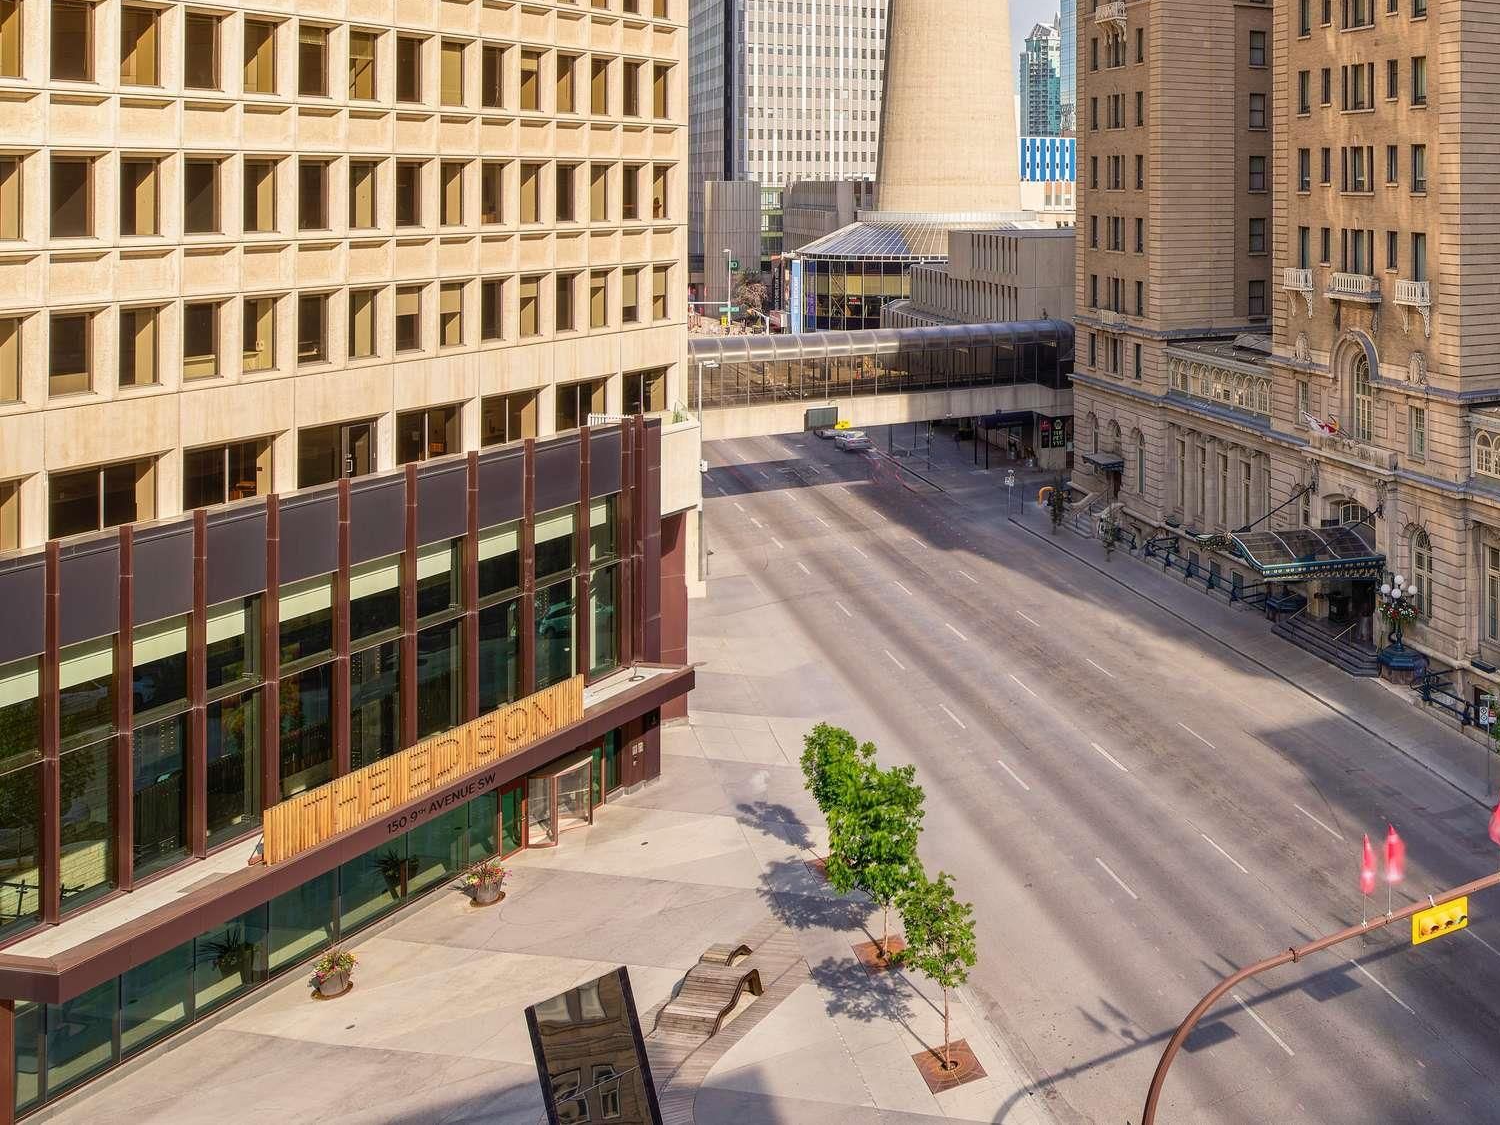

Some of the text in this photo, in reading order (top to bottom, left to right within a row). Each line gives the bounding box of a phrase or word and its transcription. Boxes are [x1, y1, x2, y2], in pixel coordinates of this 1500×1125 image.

[303, 693, 554, 831] THE EDISON
[386, 817, 408, 835] 150
[428, 782, 475, 814] AVENUE
[477, 773, 496, 789] SW
